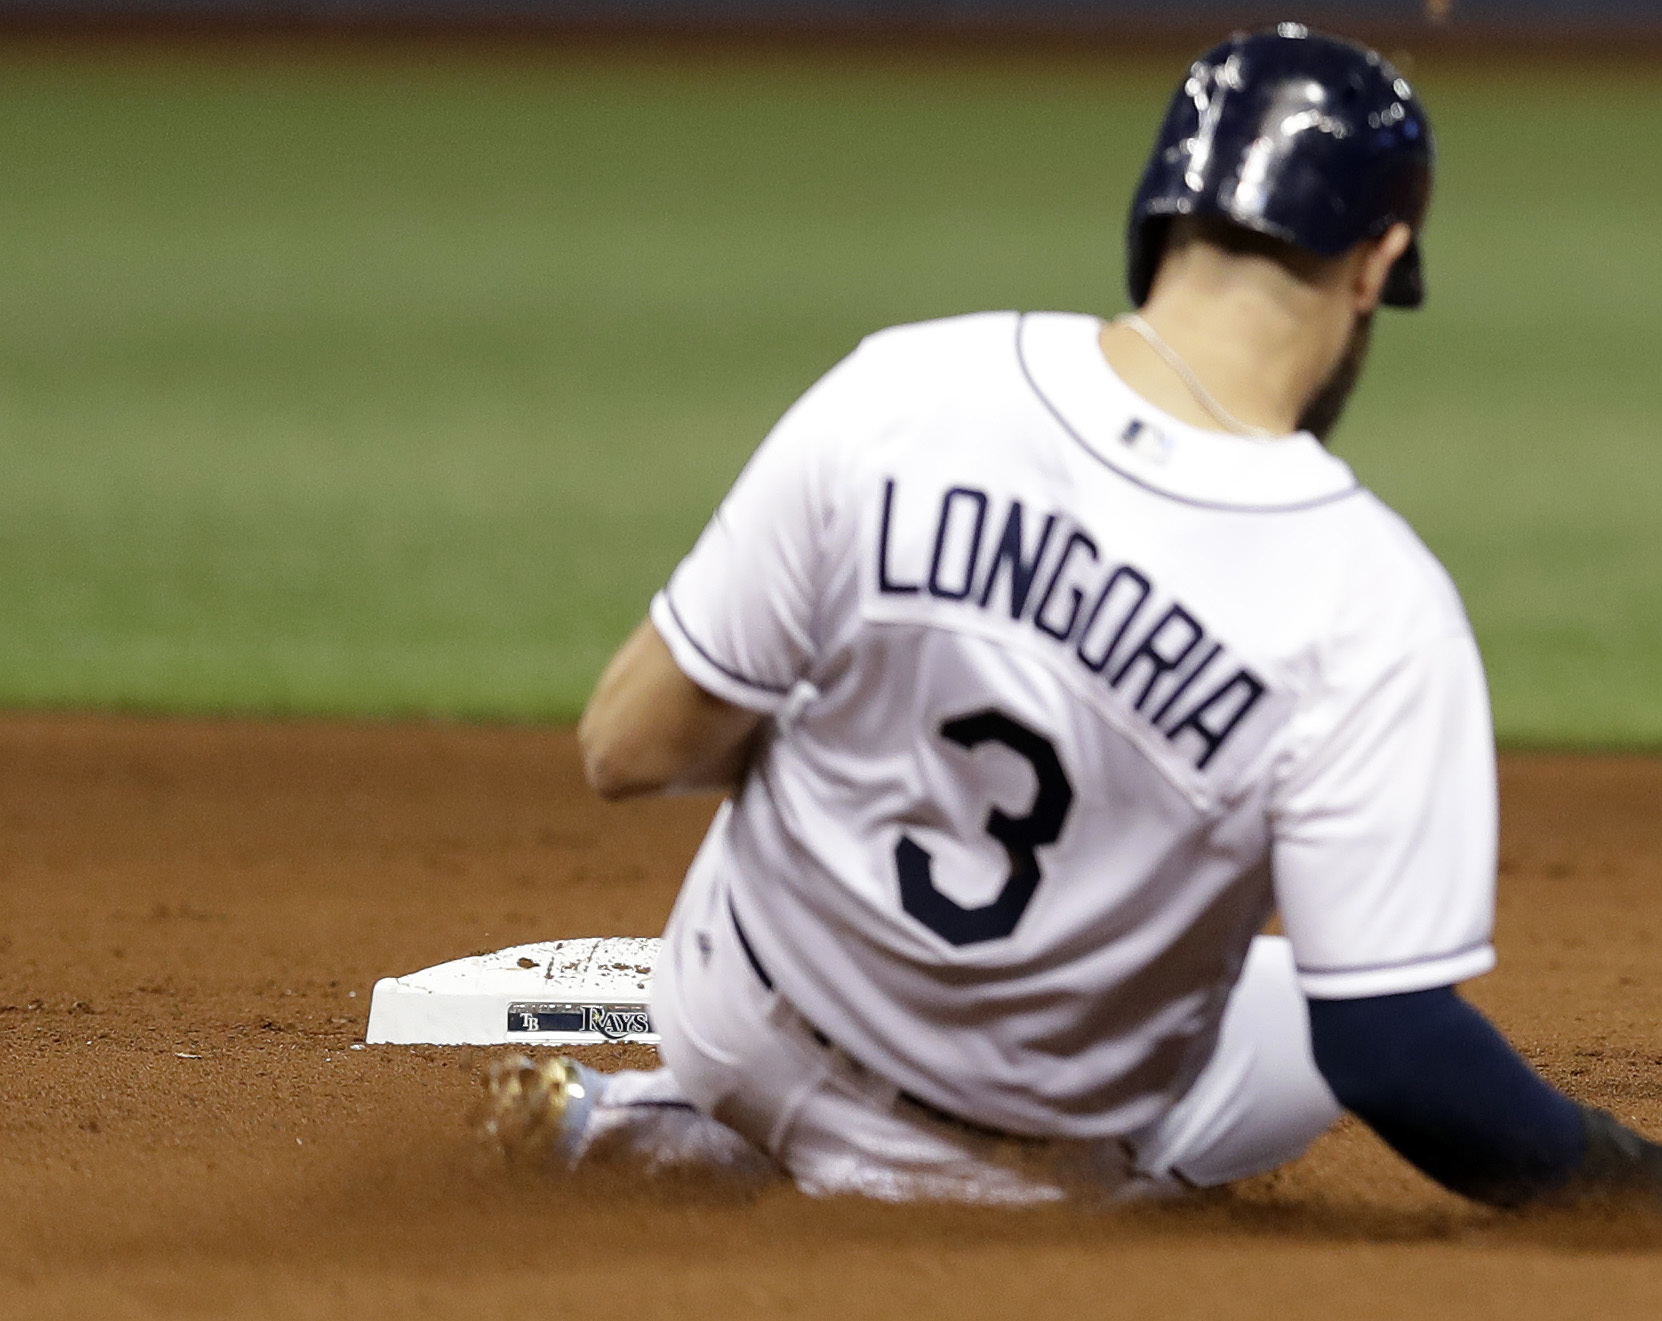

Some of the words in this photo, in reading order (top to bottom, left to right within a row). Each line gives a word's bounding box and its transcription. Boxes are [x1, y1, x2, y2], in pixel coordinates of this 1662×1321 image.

[877, 477, 1269, 771] LONGORIA
[894, 706, 1075, 948] 3
[519, 1013, 539, 1031] TB
[579, 1006, 648, 1039] RAYS
